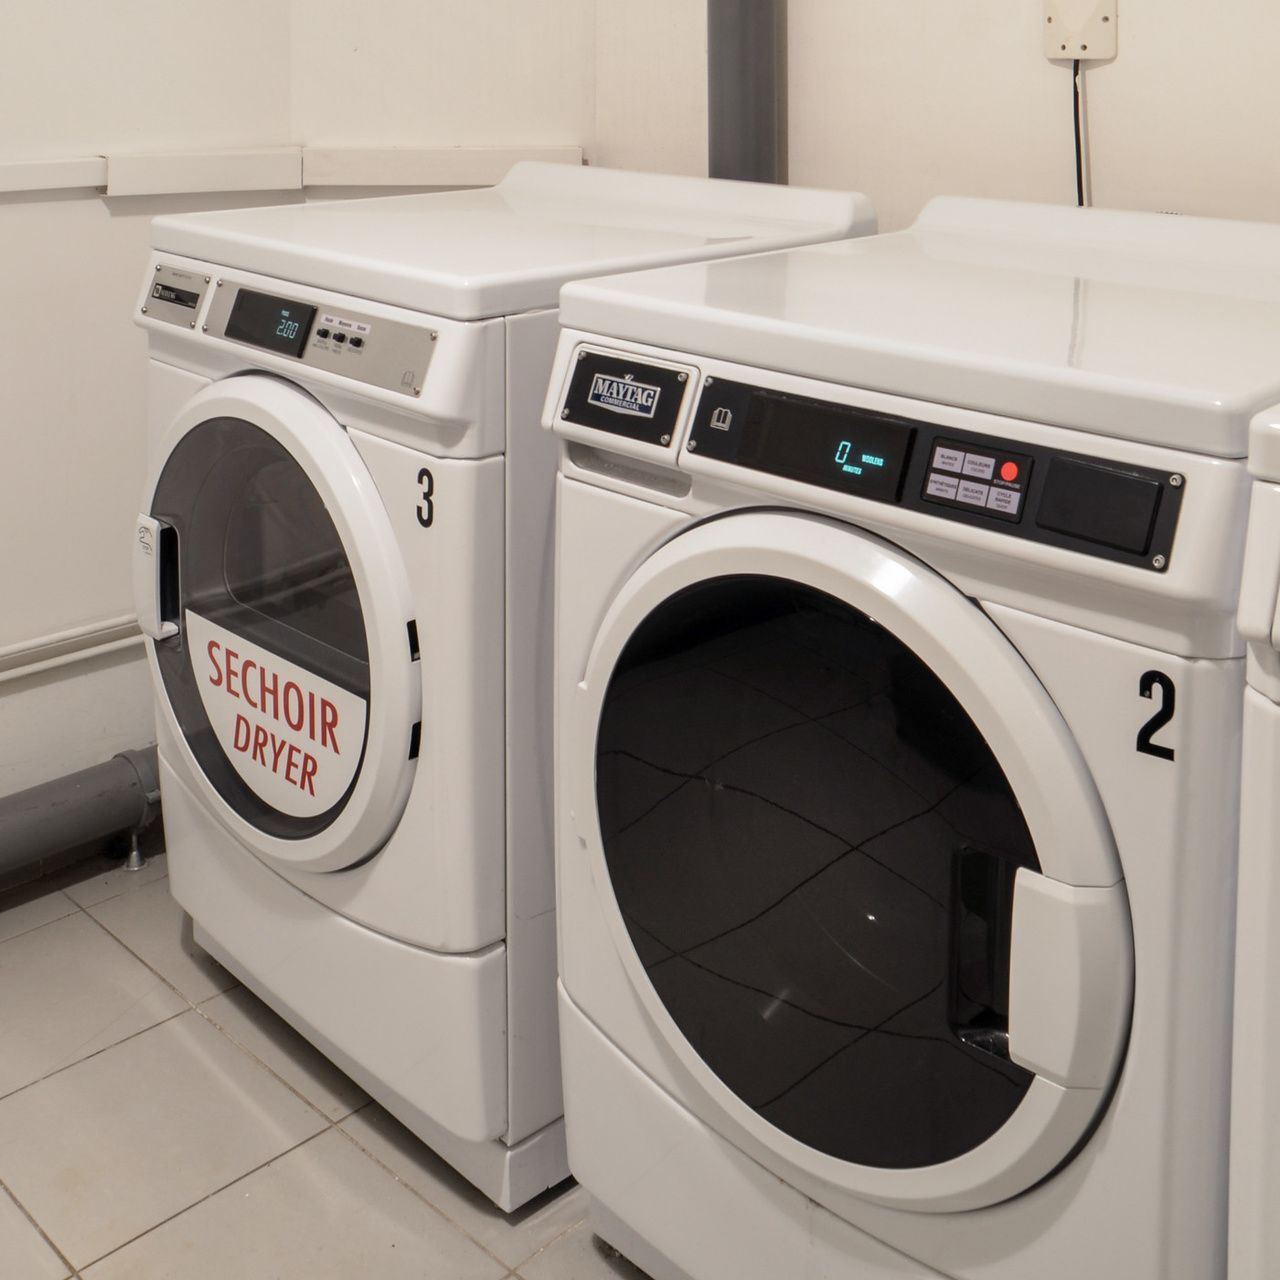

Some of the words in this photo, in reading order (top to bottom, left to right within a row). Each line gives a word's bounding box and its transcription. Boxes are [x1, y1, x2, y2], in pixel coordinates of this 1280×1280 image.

[594, 378, 655, 407] MAYTAG
[600, 395, 639, 411] COMMERCIAL
[835, 440, 851, 463] 0
[416, 467, 434, 528] 3
[207, 639, 340, 756] SECHOIR
[1136, 669, 1176, 762] 2
[233, 713, 318, 797] DRYER
